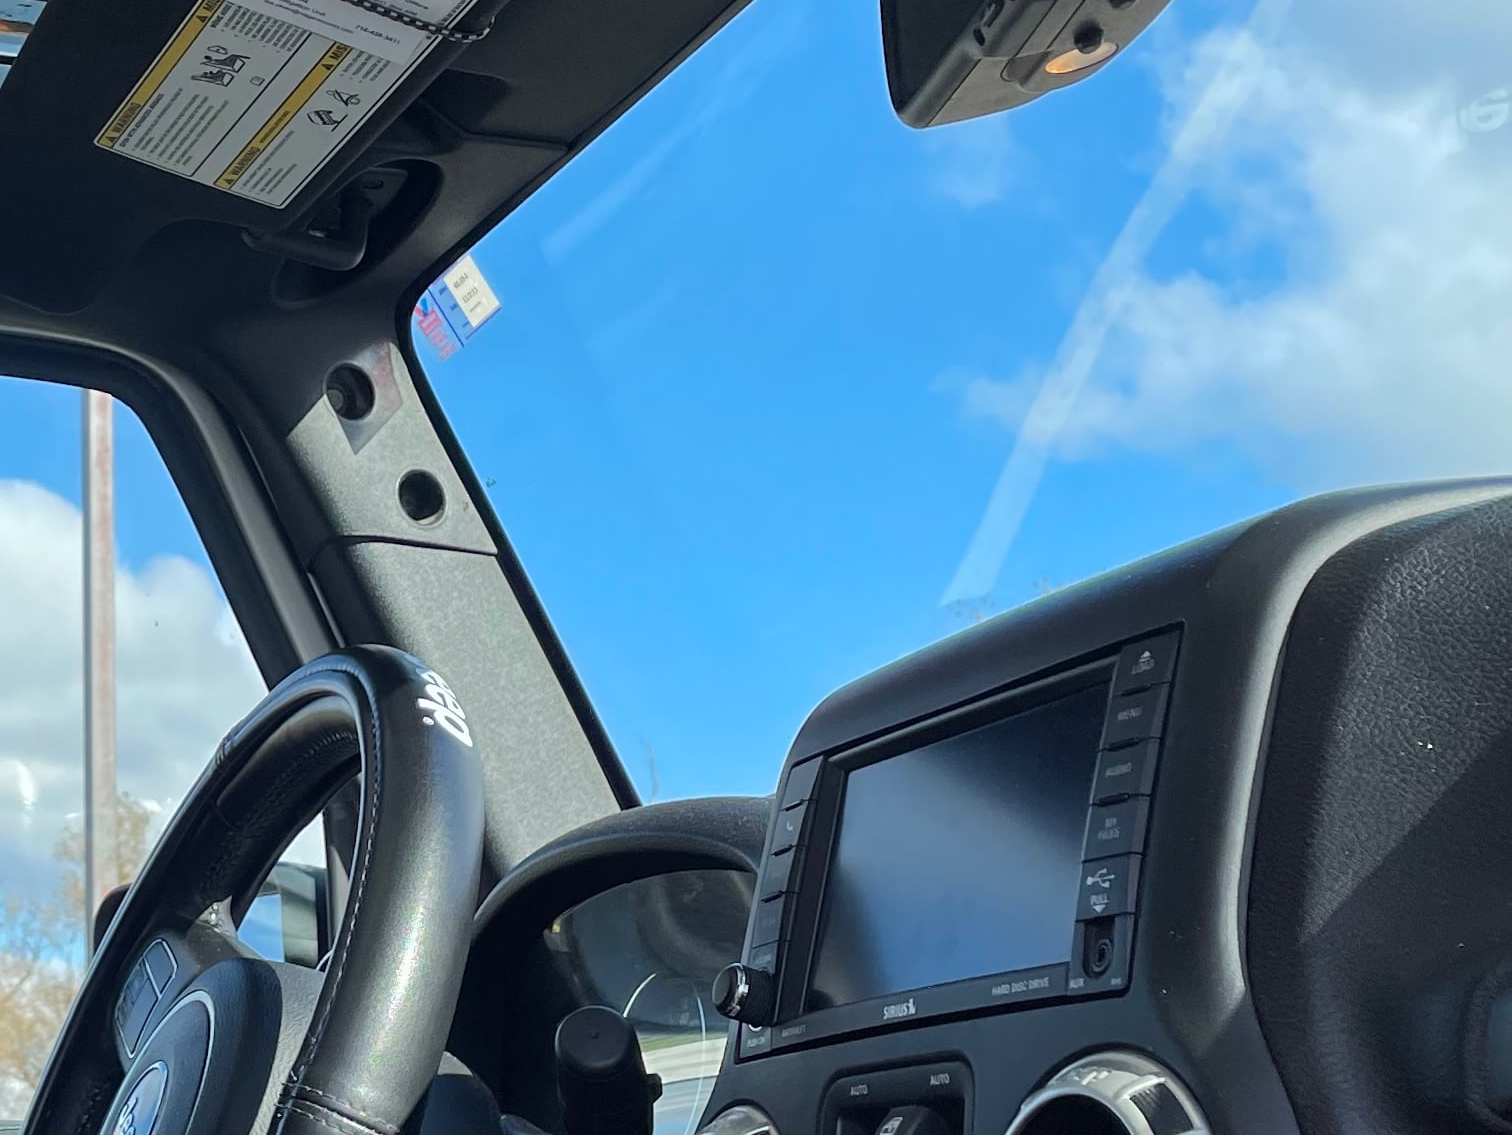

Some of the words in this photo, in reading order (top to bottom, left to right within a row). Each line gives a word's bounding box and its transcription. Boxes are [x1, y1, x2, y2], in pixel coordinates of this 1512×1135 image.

[112, 101, 144, 134] WARNING
[231, 146, 261, 176] WARNING
[991, 982, 1011, 996] HARD
[1011, 979, 1028, 993] DISC
[1028, 975, 1050, 990] DRIVE
[883, 999, 910, 1020] SIRIUS
[849, 1084, 869, 1096] AUTO
[929, 1073, 950, 1086] AUTO
